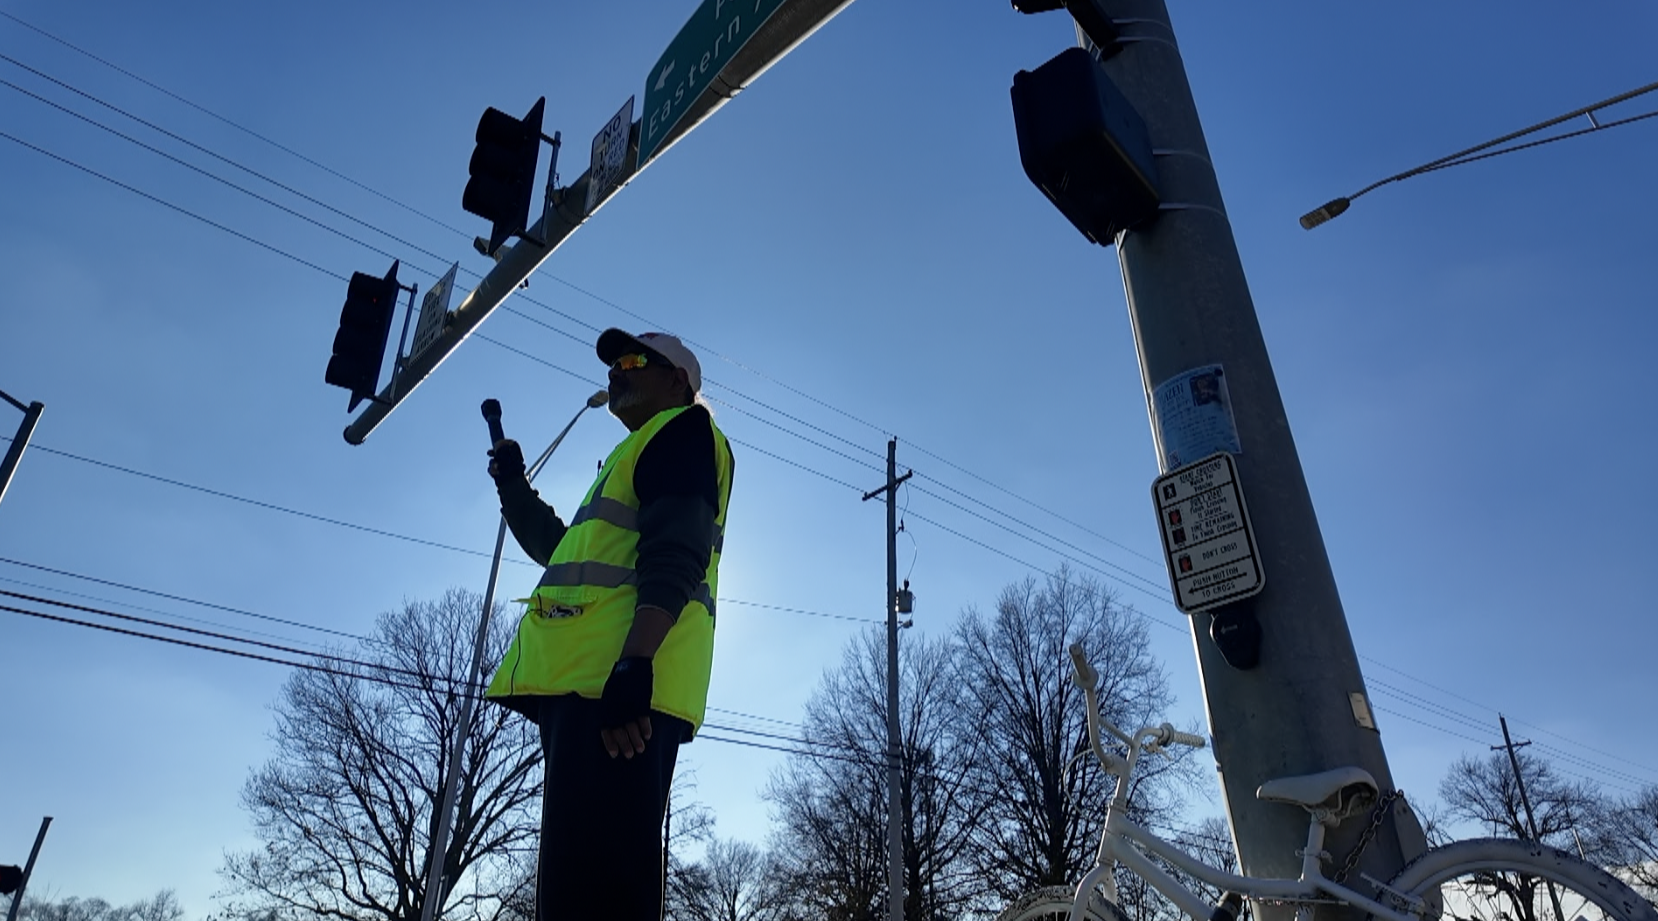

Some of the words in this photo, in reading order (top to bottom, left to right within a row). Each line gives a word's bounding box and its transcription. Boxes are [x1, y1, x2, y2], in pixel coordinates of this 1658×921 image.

[648, 15, 740, 141] Eastern
[603, 114, 621, 144] NO
[599, 128, 623, 162] TURN
[593, 161, 606, 181] ON
[1220, 542, 1238, 554] CROSS
[1193, 575, 1211, 587] PUSH
[1213, 567, 1239, 580] BUTTON
[1202, 589, 1211, 598] TO
[1213, 582, 1236, 594] CROSS
